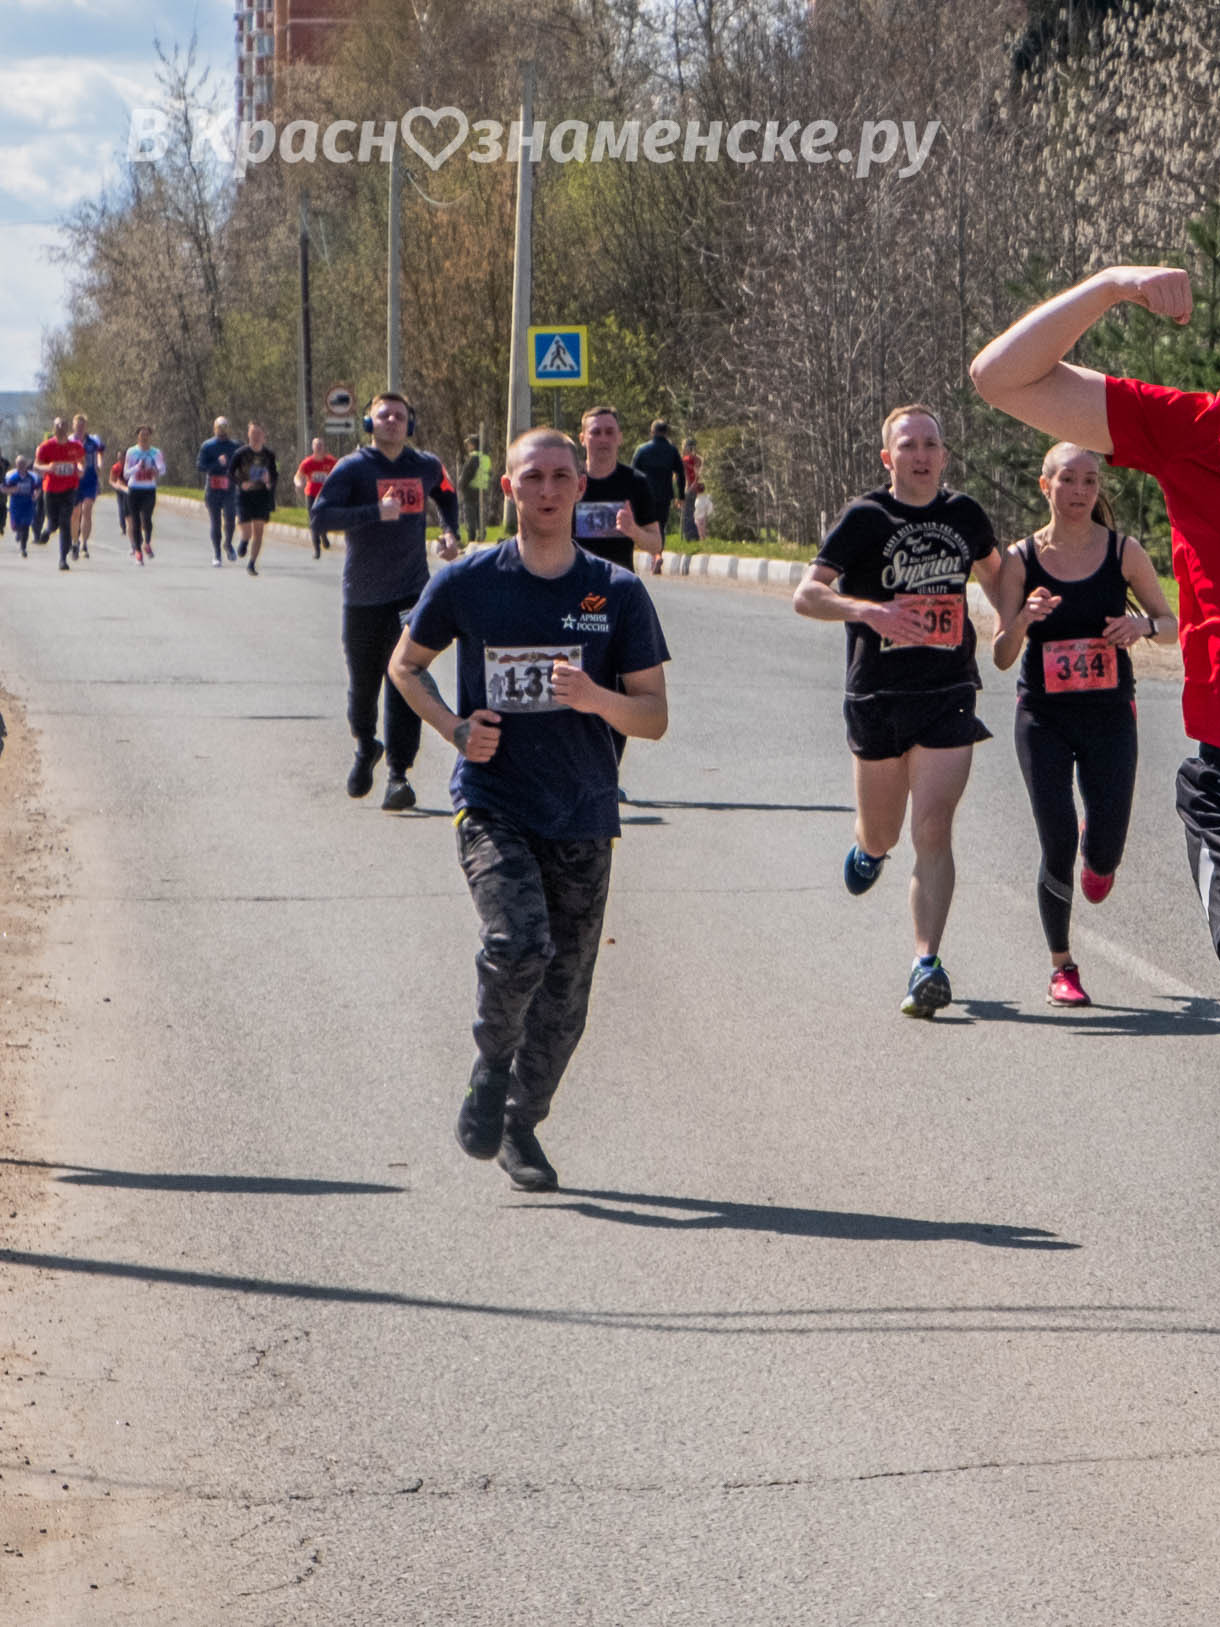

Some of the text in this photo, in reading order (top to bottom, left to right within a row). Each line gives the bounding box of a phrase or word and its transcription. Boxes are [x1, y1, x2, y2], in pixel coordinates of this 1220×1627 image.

[881, 549, 965, 591] Superior
[576, 622, 609, 632] РОССИИ
[580, 613, 607, 622] АРМИЯ
[911, 609, 952, 634] 06
[1056, 653, 1105, 681] 344
[505, 666, 555, 699] 13
